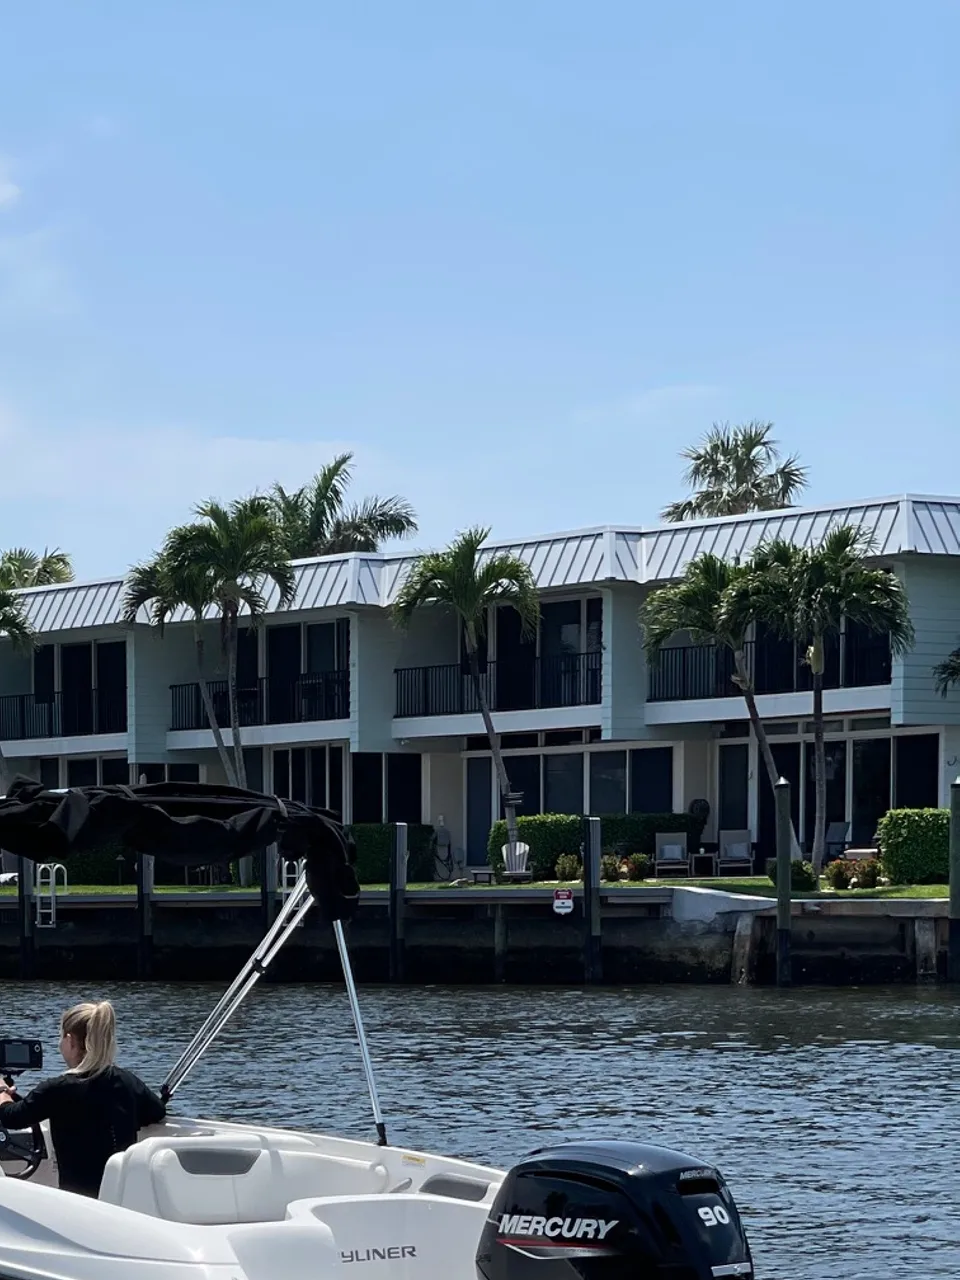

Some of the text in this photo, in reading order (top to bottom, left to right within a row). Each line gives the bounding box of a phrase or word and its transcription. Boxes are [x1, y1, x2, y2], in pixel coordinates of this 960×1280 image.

[498, 1213, 620, 1240] MERCURY
[697, 1205, 730, 1227] 90
[337, 1245, 417, 1263] YLINER
